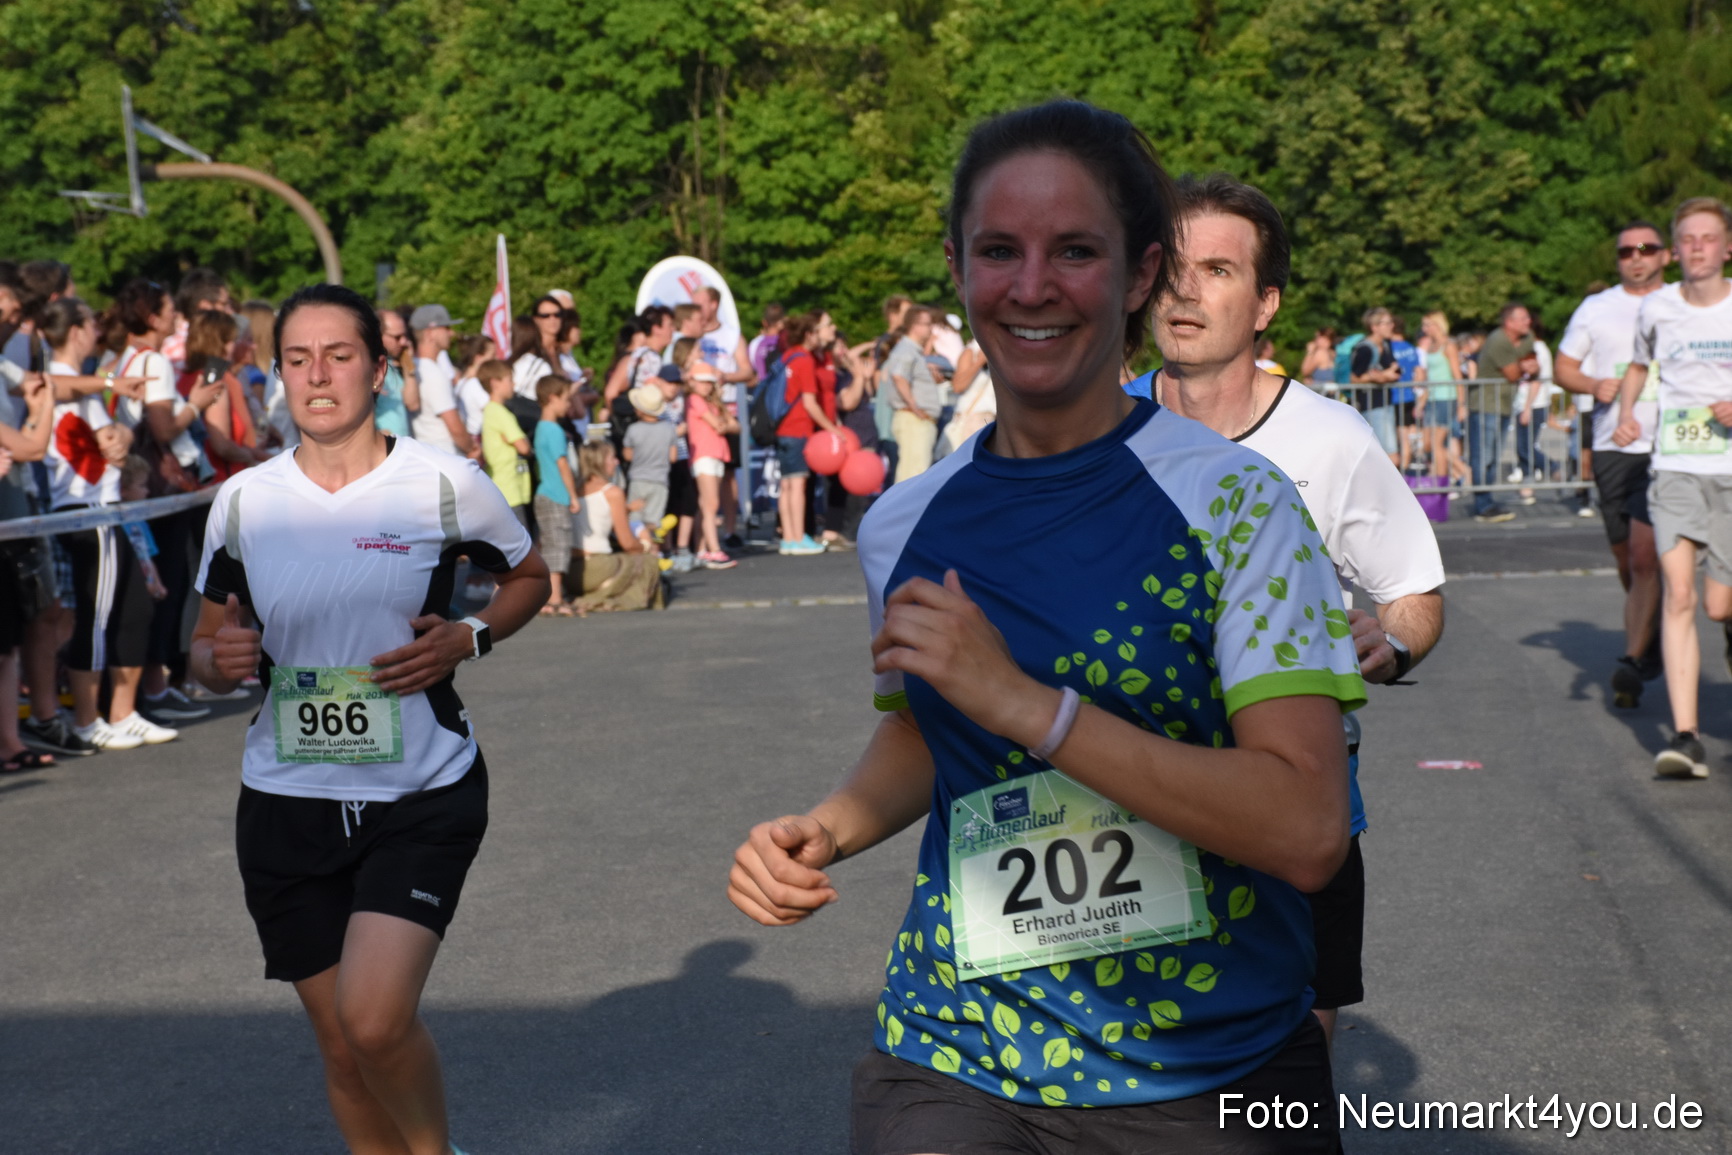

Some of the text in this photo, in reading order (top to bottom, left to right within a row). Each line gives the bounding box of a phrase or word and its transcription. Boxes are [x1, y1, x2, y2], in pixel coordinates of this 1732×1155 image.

[1675, 424, 1712, 441] 993
[364, 543, 411, 551] partner
[298, 701, 369, 737] 966
[294, 748, 332, 756] guttenberger
[358, 746, 380, 754] GmbH
[297, 737, 375, 747] Walter Ludowika
[980, 805, 1066, 841] firmenlauf
[997, 829, 1142, 916] 202
[1012, 898, 1142, 935] Erhard Judith
[1037, 928, 1100, 946] Bionorica
[1103, 922, 1122, 935] SE
